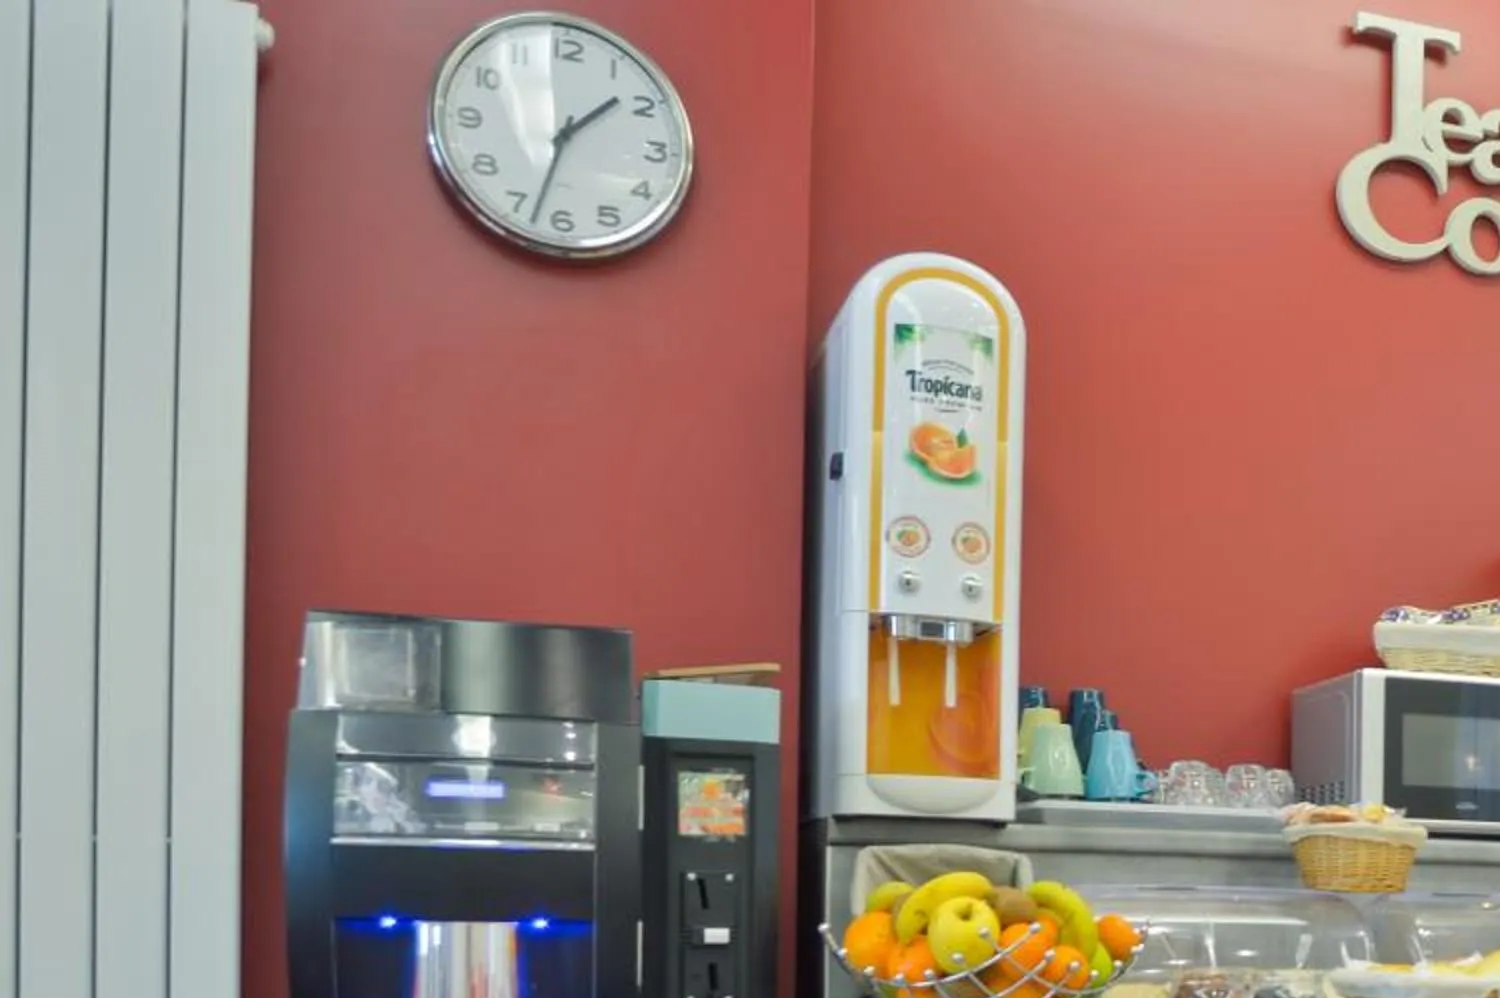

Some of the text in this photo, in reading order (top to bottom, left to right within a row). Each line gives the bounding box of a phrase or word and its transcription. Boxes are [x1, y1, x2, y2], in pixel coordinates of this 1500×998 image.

[511, 43, 529, 66] 11
[554, 38, 586, 63] 12
[475, 66, 500, 91] 10
[457, 107, 483, 129] 9
[632, 95, 656, 118] 2
[643, 141, 668, 163] 3
[471, 153, 498, 176] 8
[506, 190, 528, 214] 7
[629, 180, 652, 201] 4
[550, 210, 575, 233] 6
[596, 205, 622, 228] 5
[905, 369, 983, 402] Tropicana
